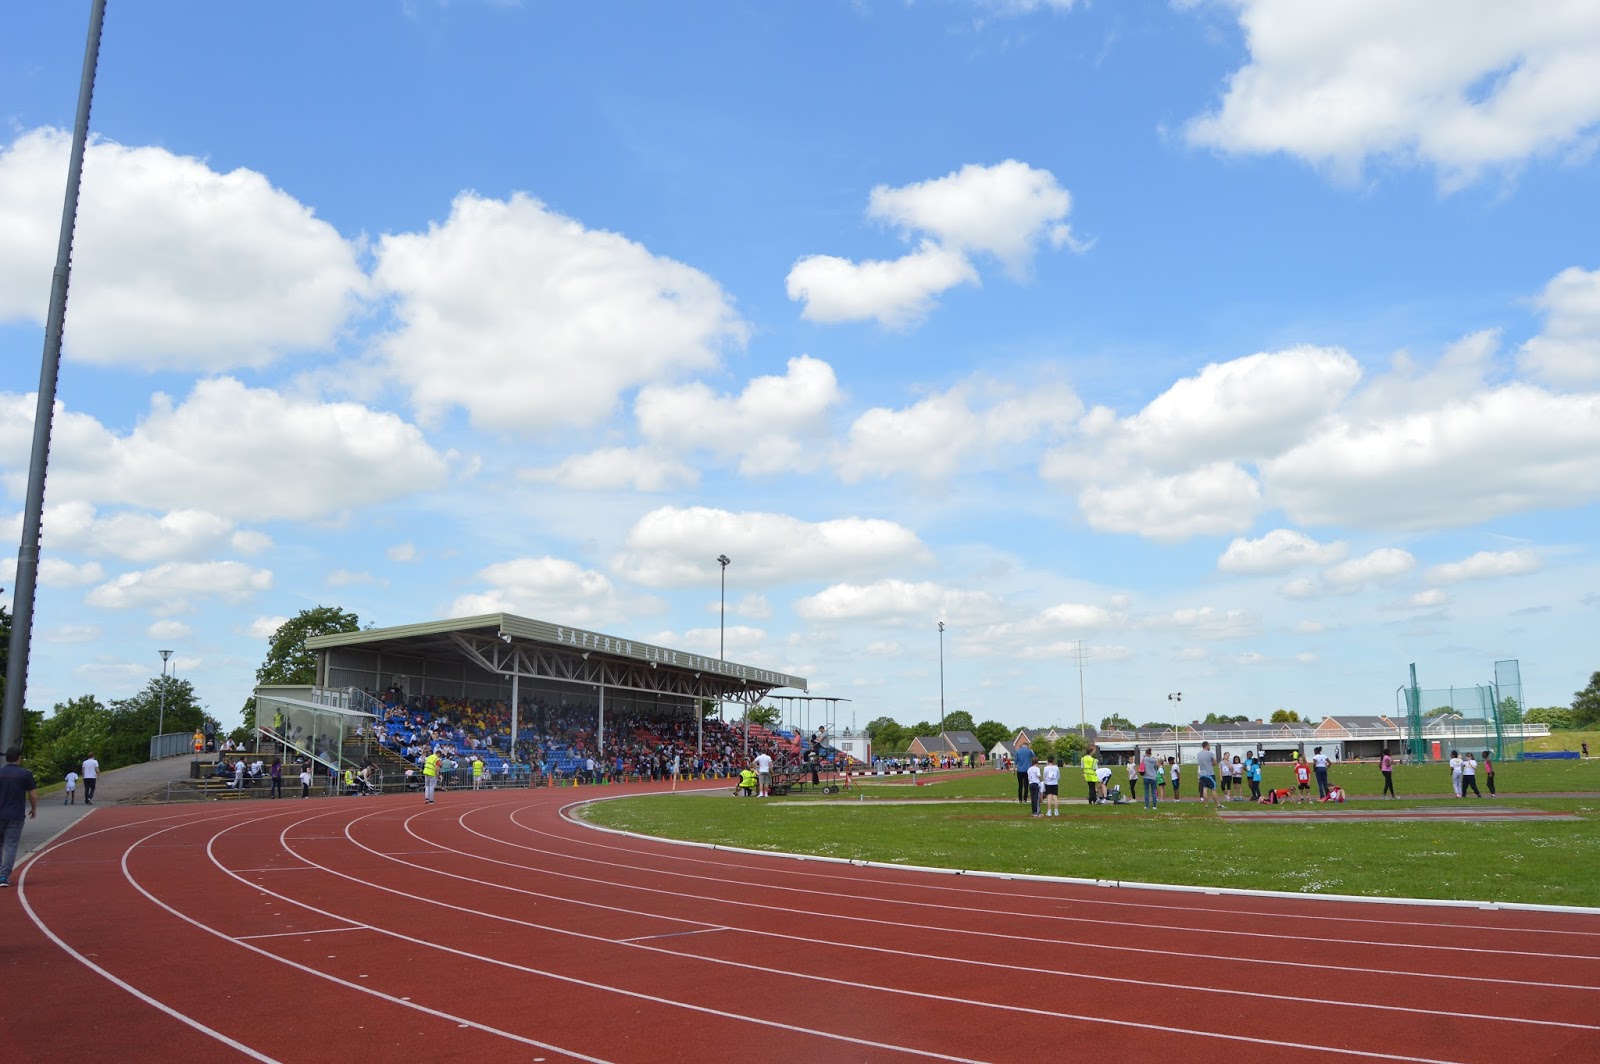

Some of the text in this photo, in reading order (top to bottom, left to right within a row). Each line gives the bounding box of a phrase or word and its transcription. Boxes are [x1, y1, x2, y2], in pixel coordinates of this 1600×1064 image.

[557, 627, 789, 685] SAFFRON LANE ATHLETICS STADIUM
